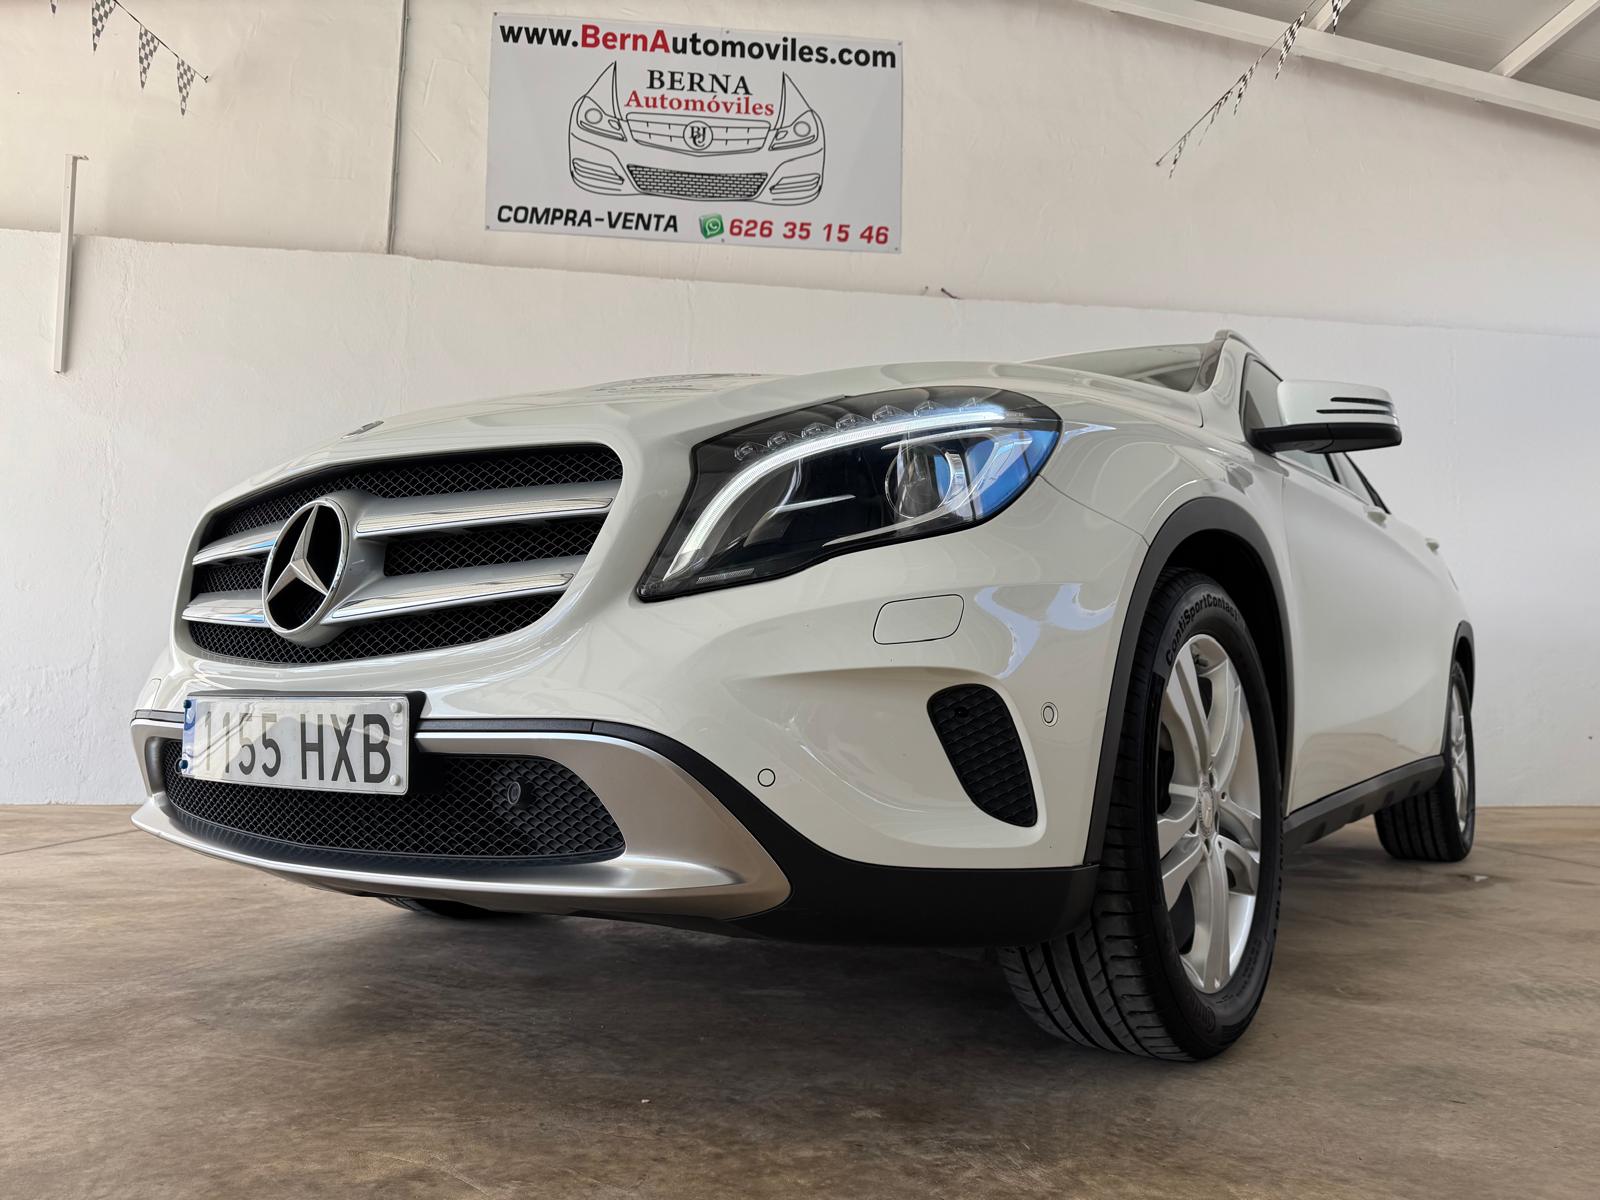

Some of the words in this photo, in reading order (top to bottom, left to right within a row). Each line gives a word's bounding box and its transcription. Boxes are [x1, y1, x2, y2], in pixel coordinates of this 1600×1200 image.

[499, 24, 896, 68] www.BernAutomoviles.com
[647, 69, 752, 95] BERNA
[624, 90, 774, 116] Automóviles
[497, 205, 679, 233] COMPRA-VENTA
[729, 219, 773, 239] 626
[782, 221, 812, 240] 35
[822, 223, 850, 243] 15
[859, 225, 890, 245] 46
[1166, 594, 1238, 666] ContiSportContact
[204, 711, 281, 777] 1155
[300, 714, 391, 783] HXB
